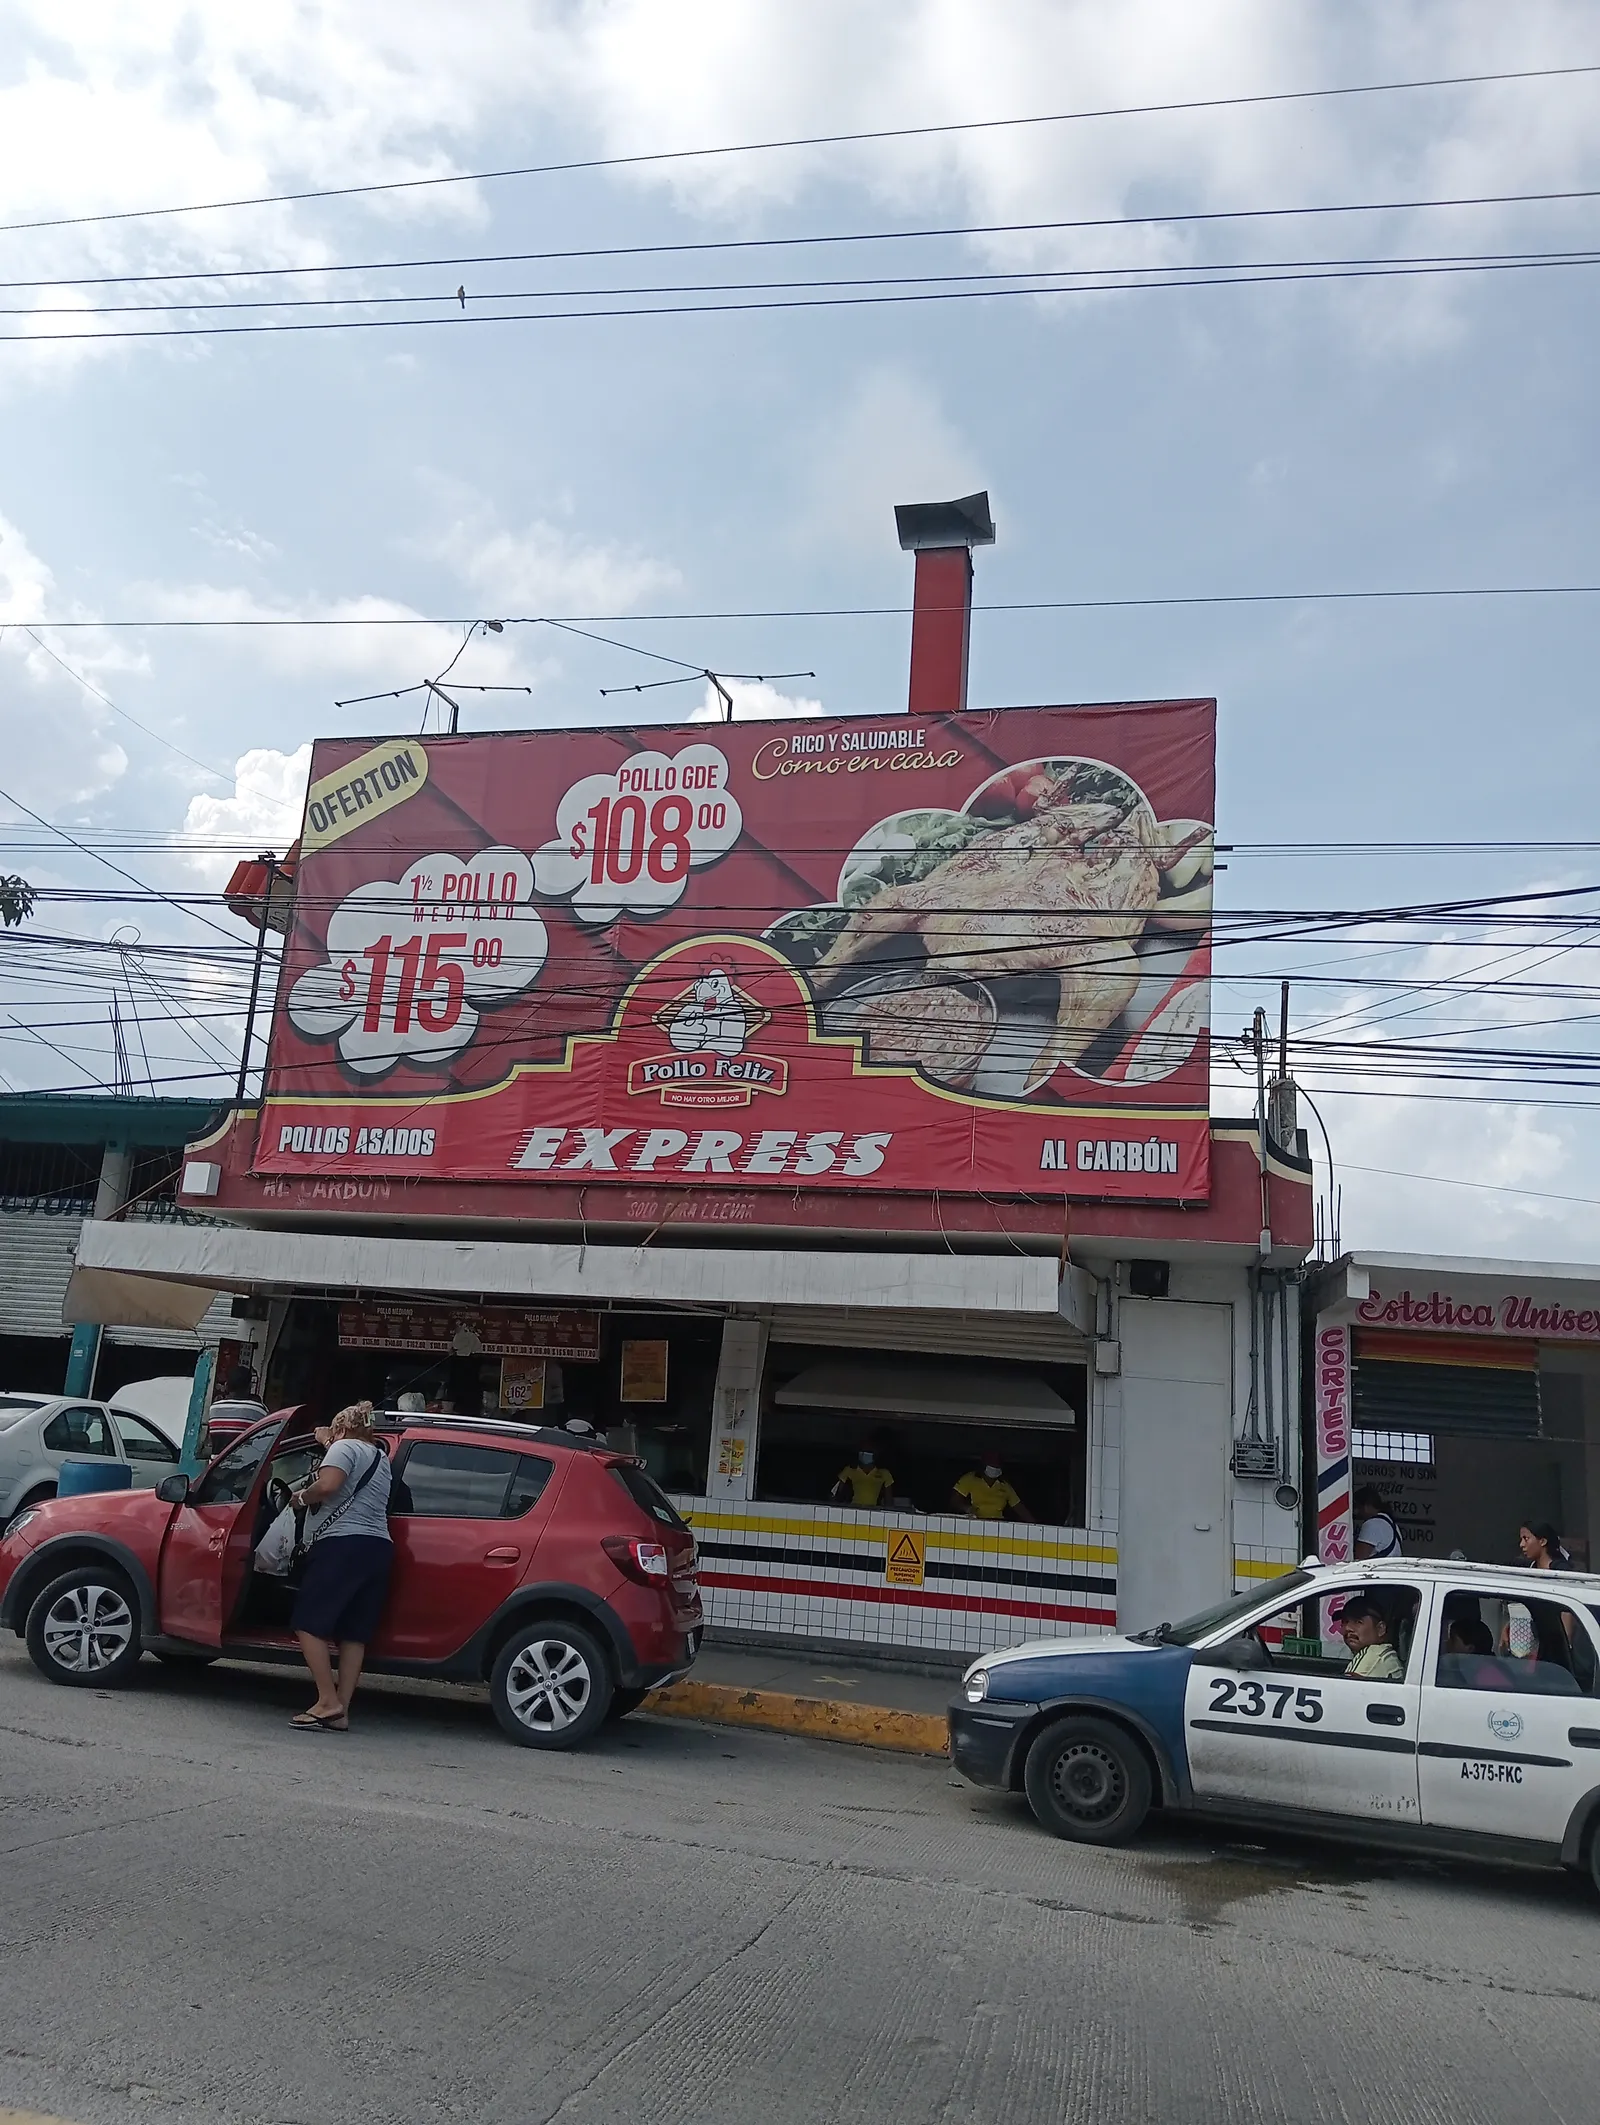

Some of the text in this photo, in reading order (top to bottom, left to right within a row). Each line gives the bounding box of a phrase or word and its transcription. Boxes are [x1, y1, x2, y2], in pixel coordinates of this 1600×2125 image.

[791, 729, 926, 754] RICO Y SALUDABLE
[752, 738, 965, 780] Como en casa
[308, 750, 419, 833] OFERTON
[618, 765, 719, 792] POLLO GDE
[442, 872, 517, 903] POLLO
[413, 904, 515, 923] MEDIANO
[642, 1059, 775, 1083] Pollo Feliz
[717, 1095, 740, 1103] MEJOR
[278, 1126, 436, 1156] POLLOS ASADOS
[506, 1127, 893, 1176] EXPRESS
[1040, 1136, 1178, 1173] AL CARBÓN
[627, 1201, 657, 1218] SOLO
[1358, 1290, 1496, 1327] Estetica
[1321, 1329, 1346, 1454] CORTES
[1400, 1466, 1415, 1479] NO
[1417, 1467, 1437, 1480] SON
[1422, 1503, 1432, 1515] Y
[1208, 1678, 1324, 1723] 2375
[1461, 1761, 1523, 1784] A-375-FKC
